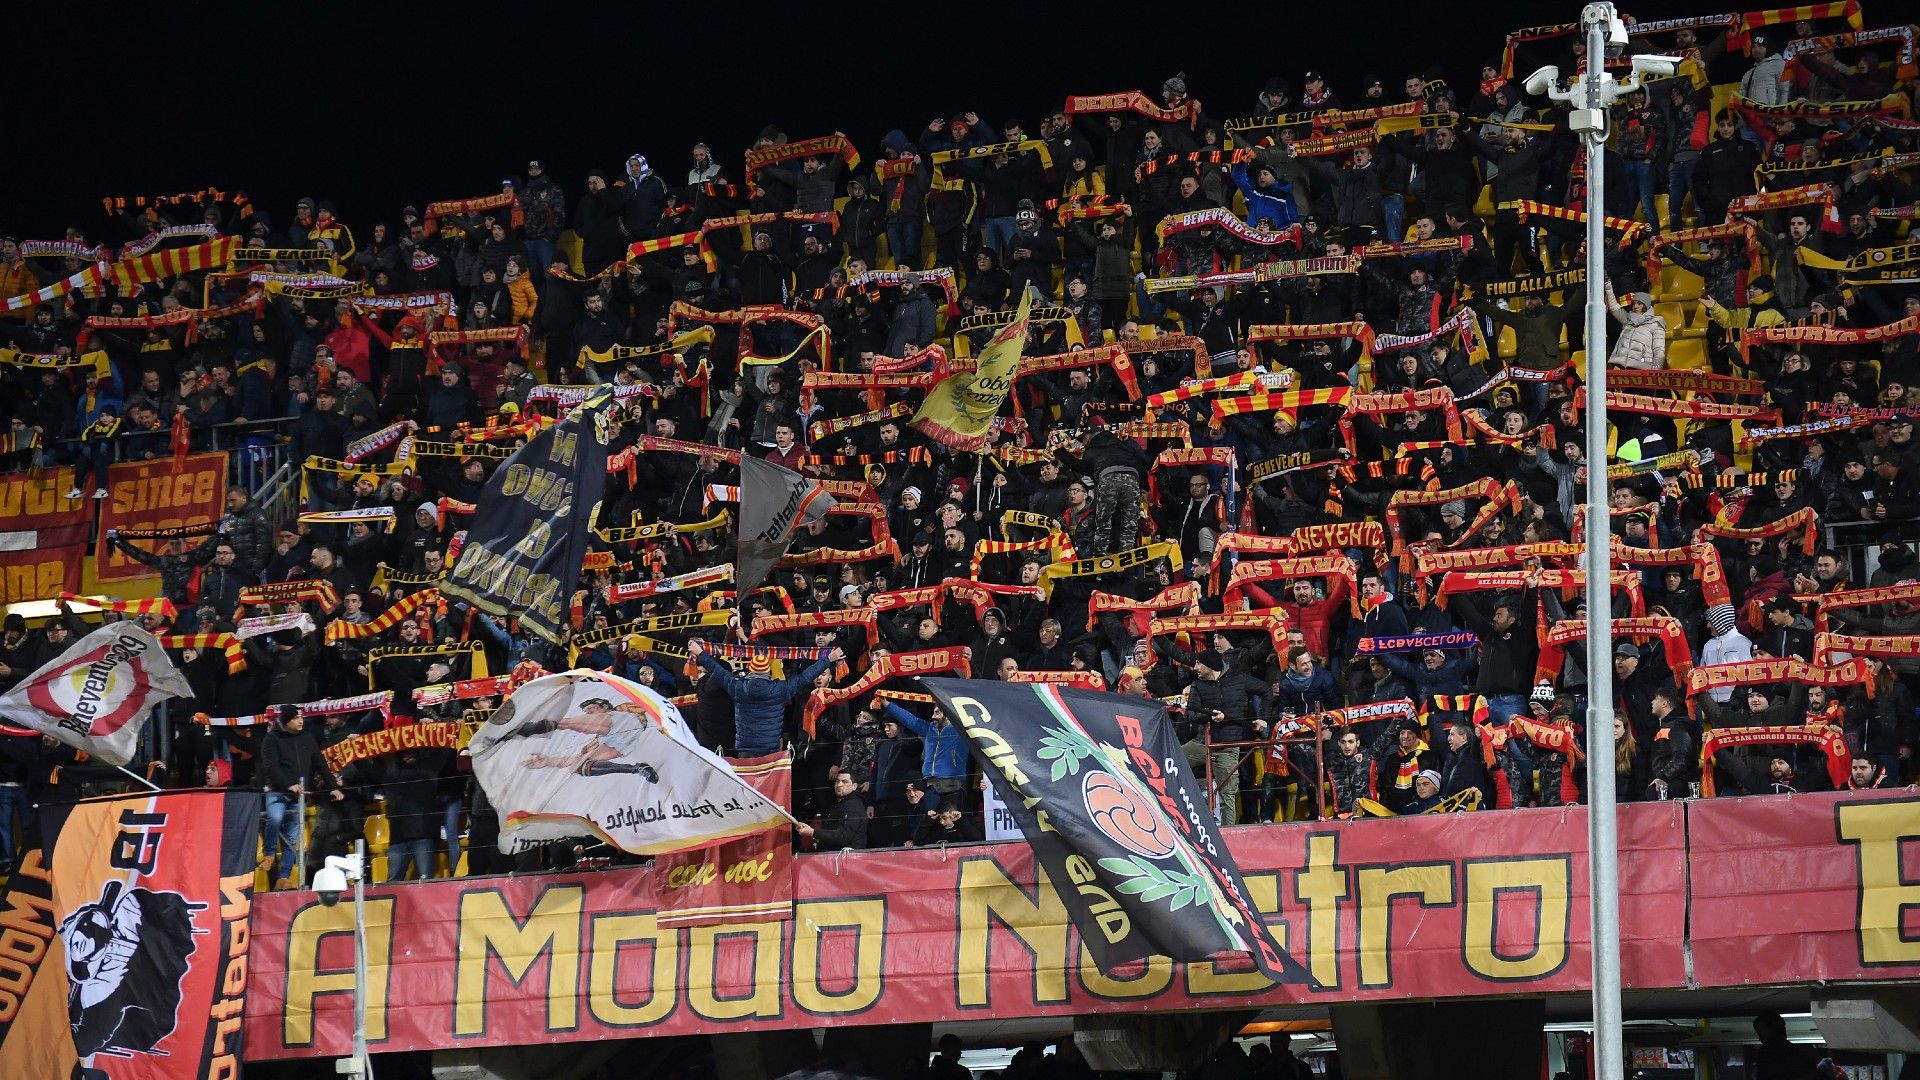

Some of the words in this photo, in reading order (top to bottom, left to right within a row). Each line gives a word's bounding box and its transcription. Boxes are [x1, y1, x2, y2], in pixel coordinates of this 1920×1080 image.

[1075, 91, 1188, 120] BENEVENTO
[1184, 210, 1243, 235] BENEVENTO
[1487, 281, 1516, 297] FINO
[1520, 276, 1554, 293] ALLA
[1556, 268, 1586, 287] FINE
[407, 294, 436, 307] CON
[1765, 326, 1859, 342] CURVA
[1865, 315, 1918, 341] SUD
[804, 372, 934, 387] BENEVENTO
[1510, 367, 1546, 379] 1929
[1700, 402, 1759, 416] SUD
[1252, 451, 1311, 478] BENEVENTO
[112, 467, 216, 514] since
[1419, 549, 1509, 574] CURVA
[575, 624, 650, 647] CURVA
[655, 611, 704, 630] SUD
[823, 608, 872, 624] SUD
[823, 655, 897, 704] CURVA
[899, 650, 950, 673] SUD
[1691, 659, 1858, 691] BENEVENTO
[341, 723, 447, 767] BENEVENTO
[669, 864, 720, 894] con
[726, 854, 775, 888] noi
[282, 893, 396, 1048] A
[454, 882, 888, 1038] Modo
